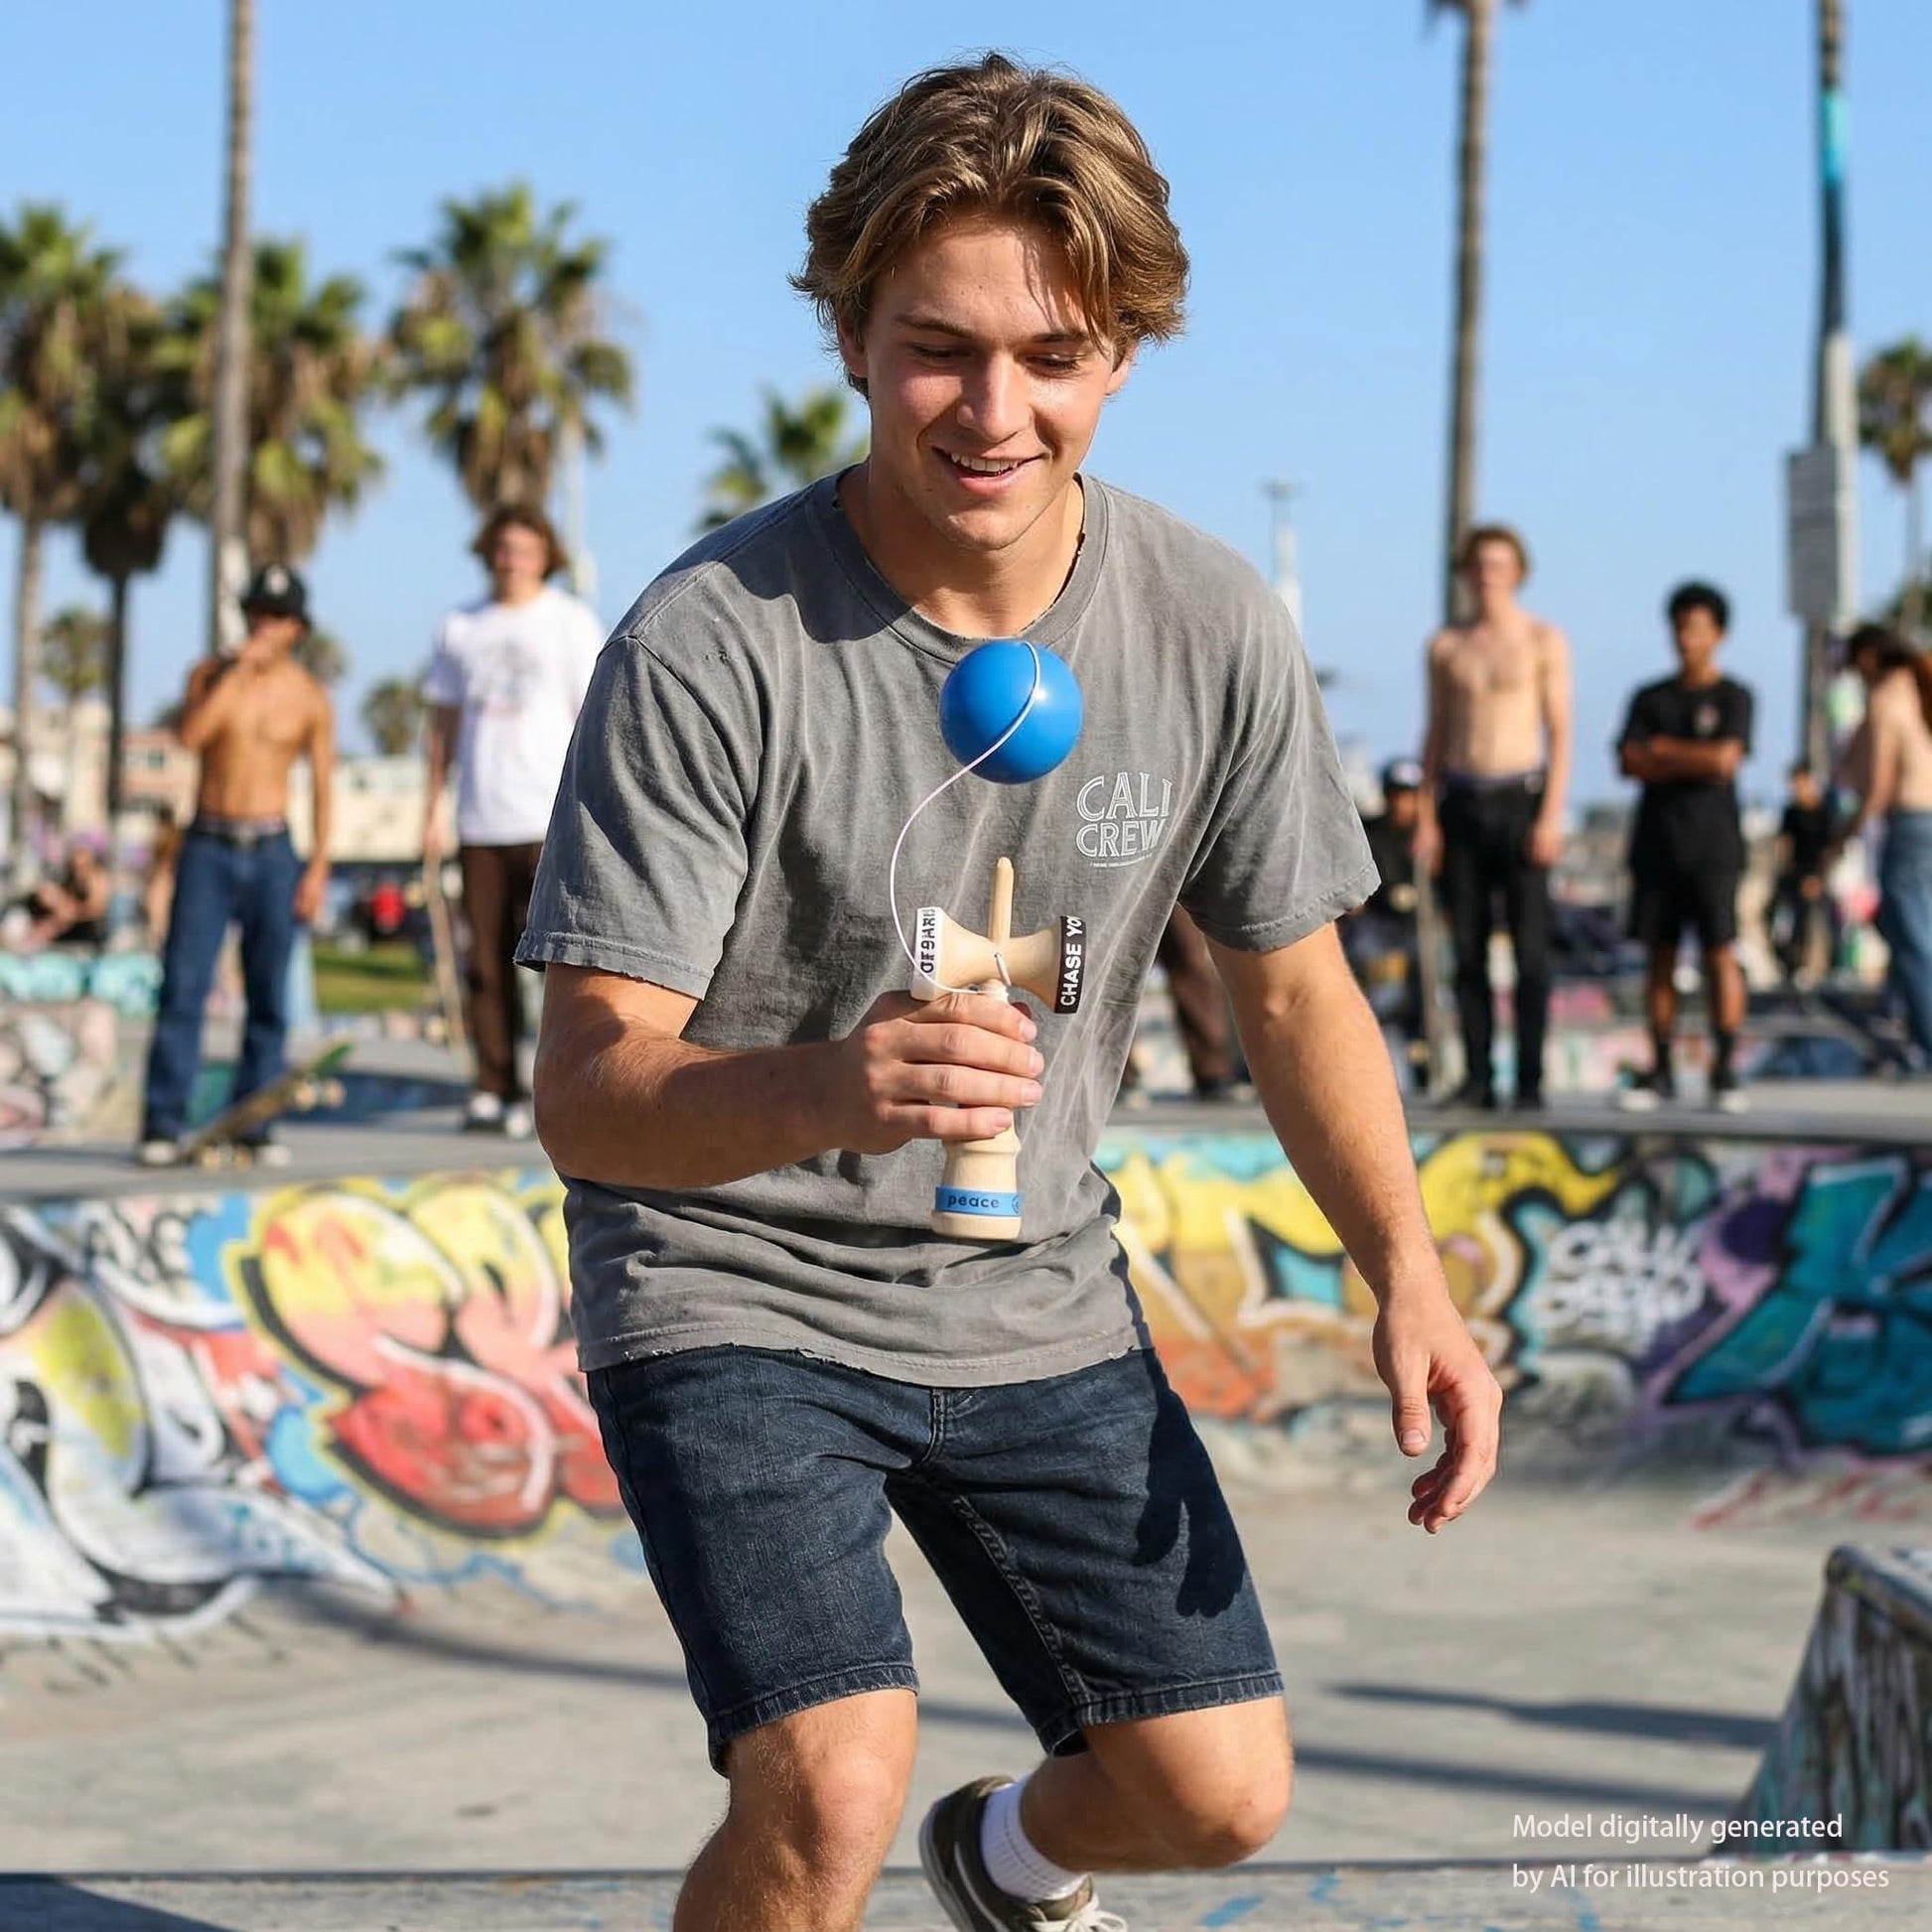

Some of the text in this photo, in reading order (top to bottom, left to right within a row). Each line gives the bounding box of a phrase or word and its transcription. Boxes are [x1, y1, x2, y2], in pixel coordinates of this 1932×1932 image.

[1076, 771, 1173, 822] CALI
[1075, 818, 1167, 857] CREW
[1060, 915, 1083, 1006] CHASE YO
[947, 1194, 1000, 1208] peace
